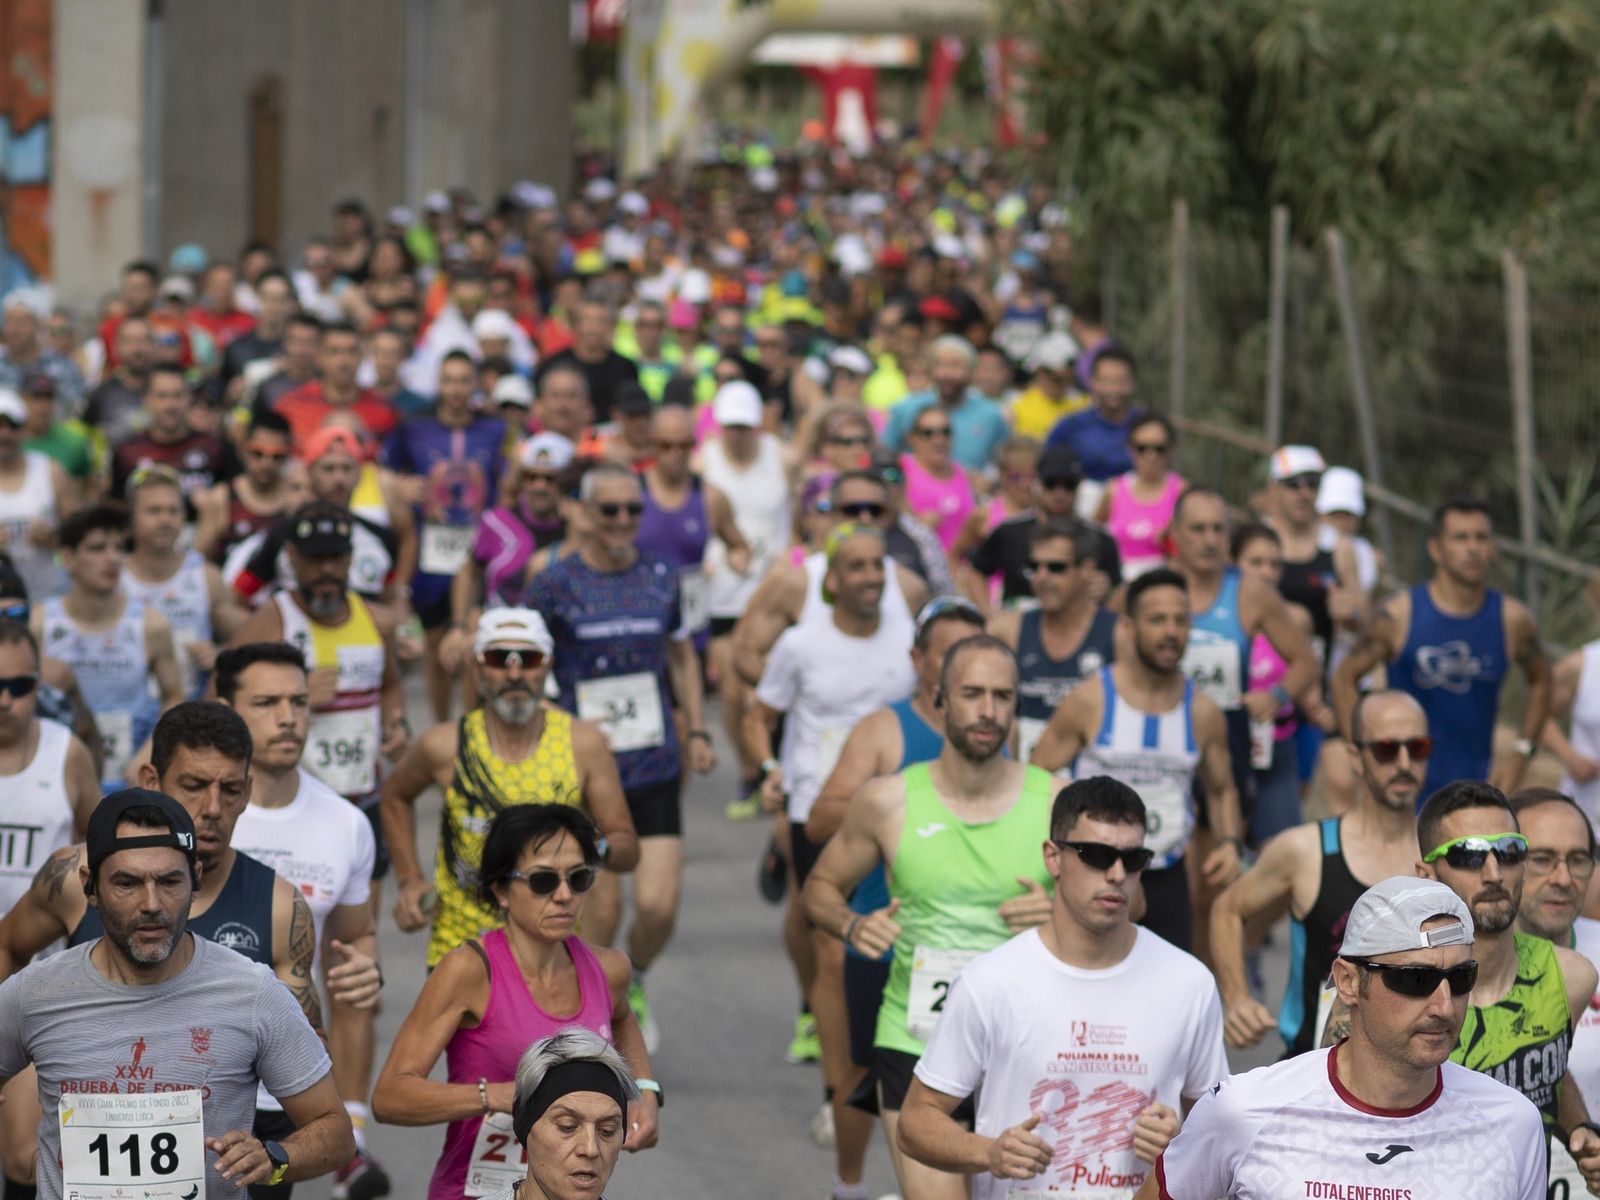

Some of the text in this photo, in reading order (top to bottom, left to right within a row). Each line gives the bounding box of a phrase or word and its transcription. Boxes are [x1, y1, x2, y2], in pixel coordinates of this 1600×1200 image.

[116, 1065, 154, 1079] XXVI
[60, 1080, 119, 1094] PRUEBA
[127, 1081, 146, 1094] DE
[171, 1095, 189, 1107] 2023
[89, 1132, 179, 1177] 118
[1072, 1163, 1145, 1188] Pulianas
